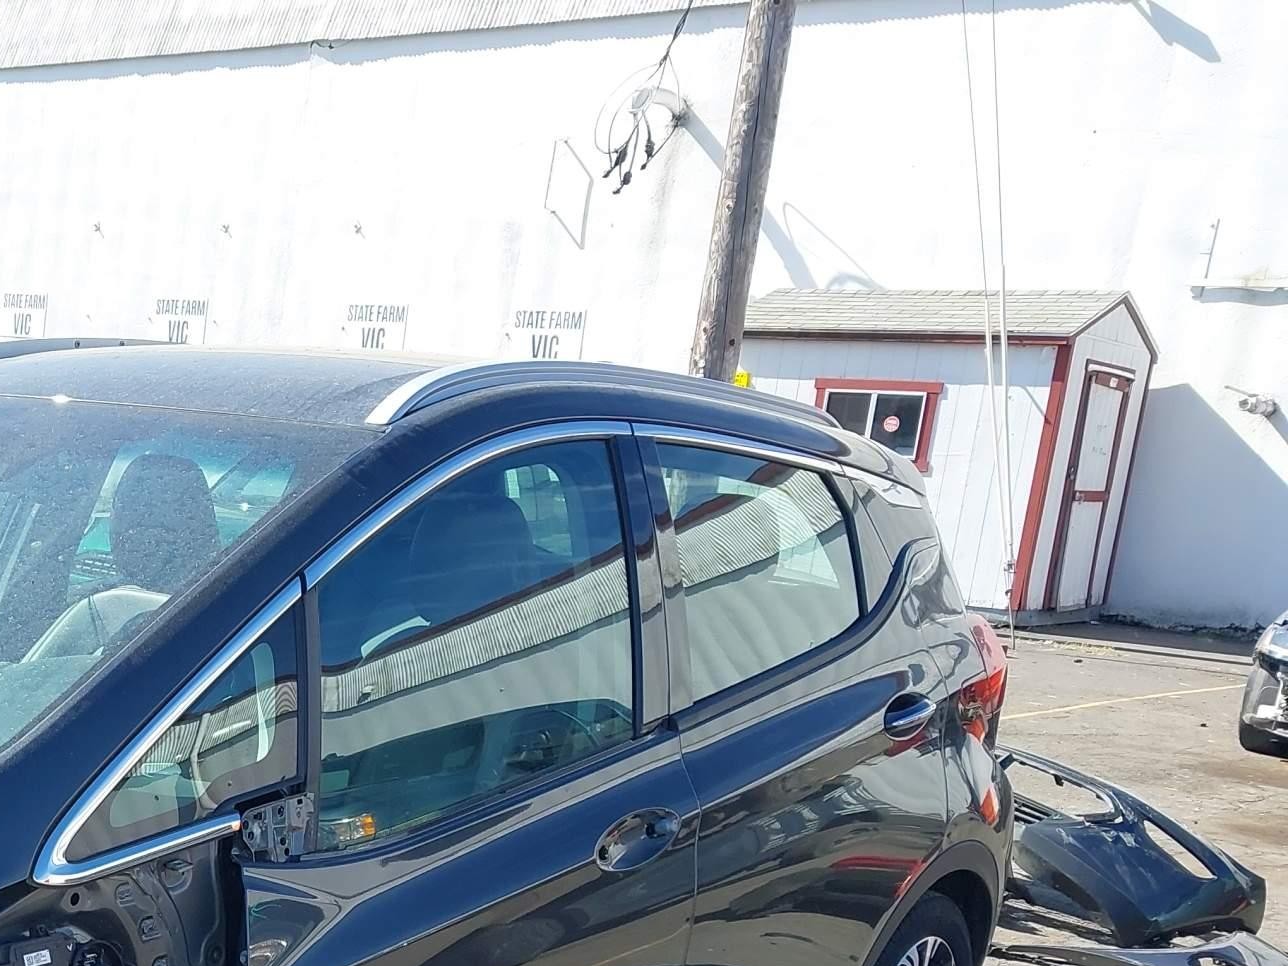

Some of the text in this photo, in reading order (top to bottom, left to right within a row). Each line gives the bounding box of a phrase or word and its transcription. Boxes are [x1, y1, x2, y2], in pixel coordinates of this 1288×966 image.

[3, 293, 45, 310] STATE FARM
[155, 299, 206, 316] STATE FARM
[13, 313, 32, 335] VIC
[347, 304, 406, 323] STATE FARM
[514, 310, 583, 330] STATE FARM
[168, 320, 189, 344] VIC
[361, 327, 385, 349] VIC
[531, 334, 559, 359] VIC
